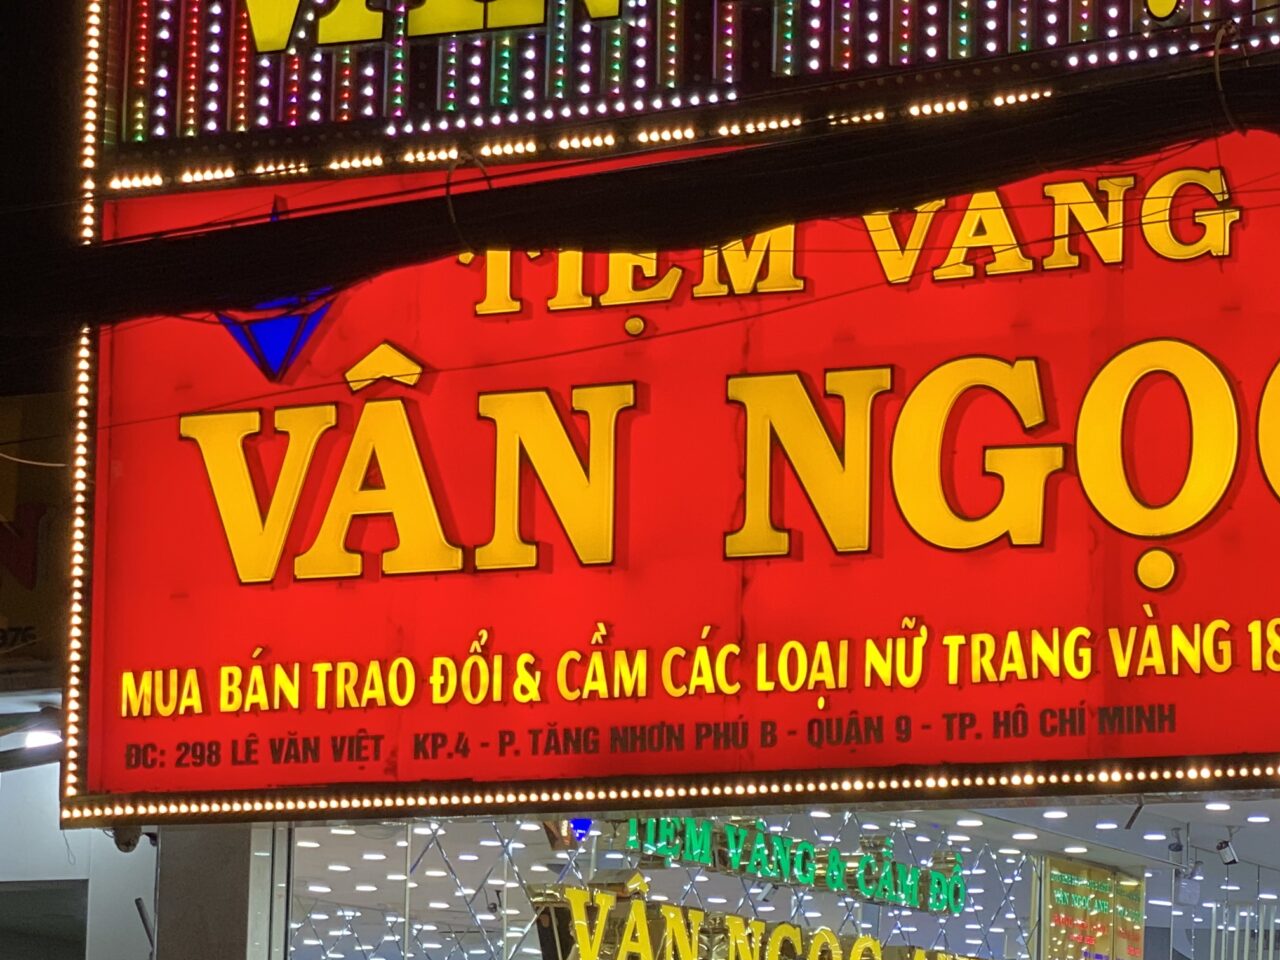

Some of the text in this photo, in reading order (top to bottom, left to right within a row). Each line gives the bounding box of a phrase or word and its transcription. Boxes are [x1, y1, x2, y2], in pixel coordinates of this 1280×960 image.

[180, 341, 637, 583] VÂN
[121, 668, 203, 717] MUA
[219, 648, 300, 713] BÁN
[312, 656, 415, 711] TRAO
[430, 629, 503, 704] ĐỔI
[513, 653, 541, 702] &
[556, 622, 647, 699] CẦM
[661, 626, 741, 697] CÁC
[756, 639, 849, 710] LOẠI
[864, 617, 928, 688] NỮ
[943, 627, 1092, 685] TRANG
[1108, 603, 1232, 678] VÀNG
[125, 743, 166, 770] ĐC:
[175, 741, 221, 768] 298
[231, 732, 258, 766] LÊ
[269, 731, 319, 764] VĂN
[331, 728, 384, 771] VIỆT
[413, 732, 471, 760] KP.4
[498, 731, 522, 757] P.
[529, 722, 599, 756] TĂNG
[609, 722, 685, 754] NHƠN
[695, 714, 749, 750] PHÚ
[761, 721, 777, 748] B
[807, 711, 884, 753] QUẬN
[895, 716, 912, 743] 9
[943, 713, 982, 741] TP.
[1039, 700, 1086, 736] CHÍ
[1098, 704, 1176, 734] MINH
[724, 818, 816, 887] VÀNG
[825, 848, 846, 892] &
[856, 836, 922, 908] CẦM
[929, 853, 966, 913] ĐỒ
